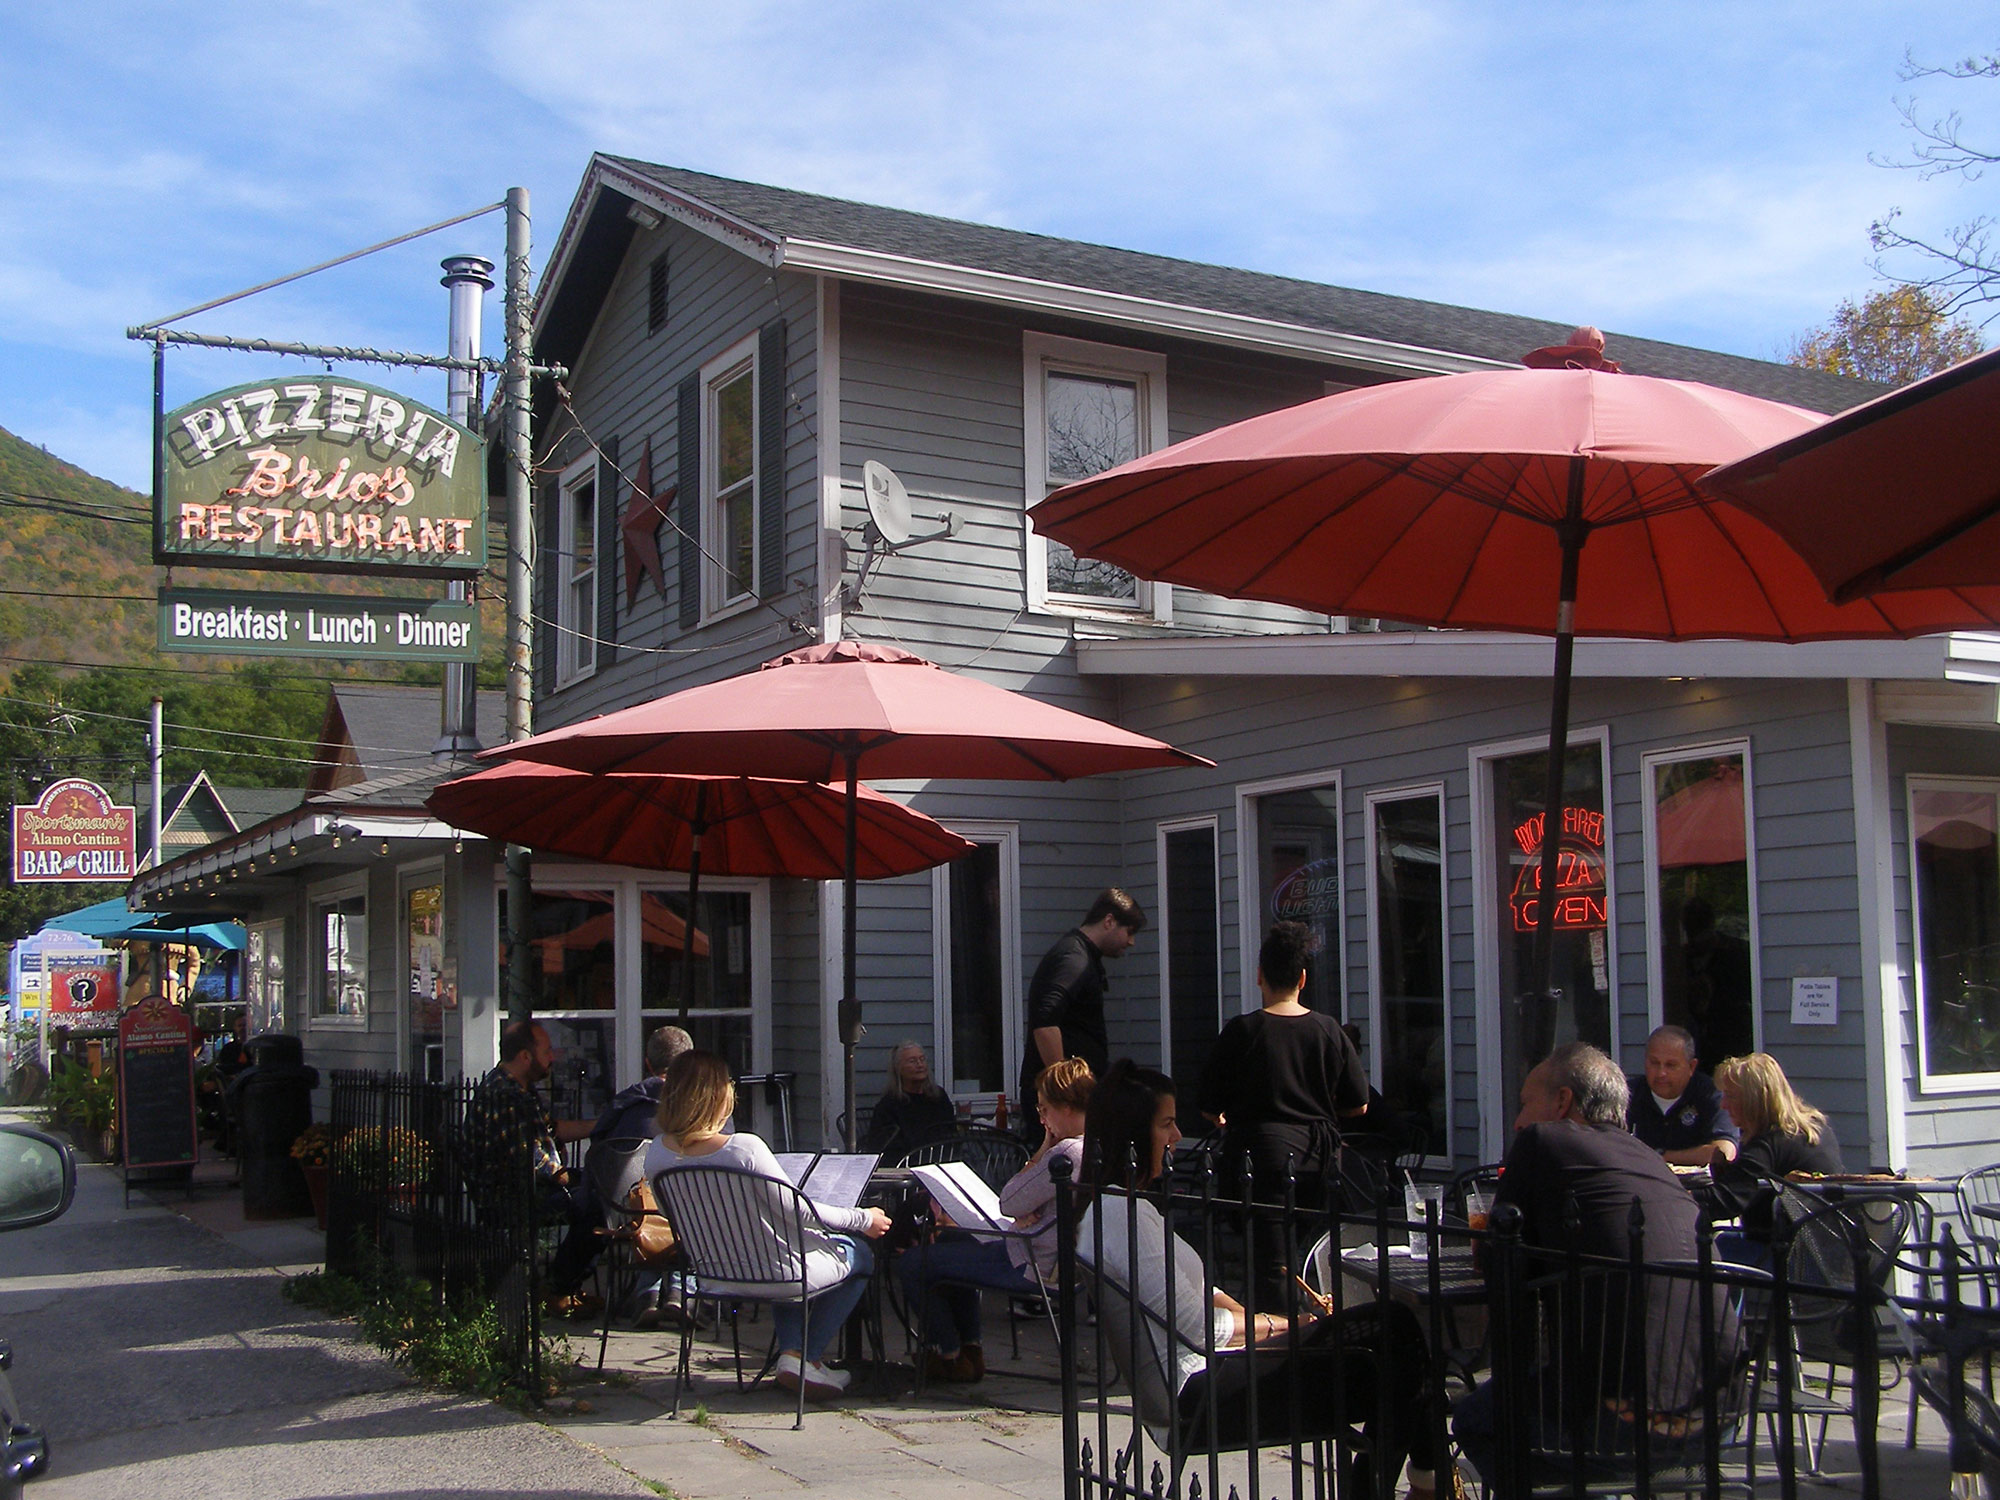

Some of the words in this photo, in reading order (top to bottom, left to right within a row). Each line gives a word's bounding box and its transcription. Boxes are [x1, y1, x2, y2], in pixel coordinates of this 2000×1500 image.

[182, 383, 460, 478] PIZZERIA
[180, 502, 473, 556] RESTAURANT
[174, 603, 288, 641] Breakfast
[308, 610, 377, 645] Lunch
[399, 612, 471, 647] Dinner
[69, 783, 99, 798] MEXICAN
[22, 811, 129, 834] Sportsman's
[32, 833, 71, 845] Alamo
[73, 832, 120, 845] Cantina
[23, 850, 62, 875] BAR
[78, 850, 130, 875] GRILL
[47, 933, 73, 942] 72-76
[126, 1033, 153, 1041] Alamo
